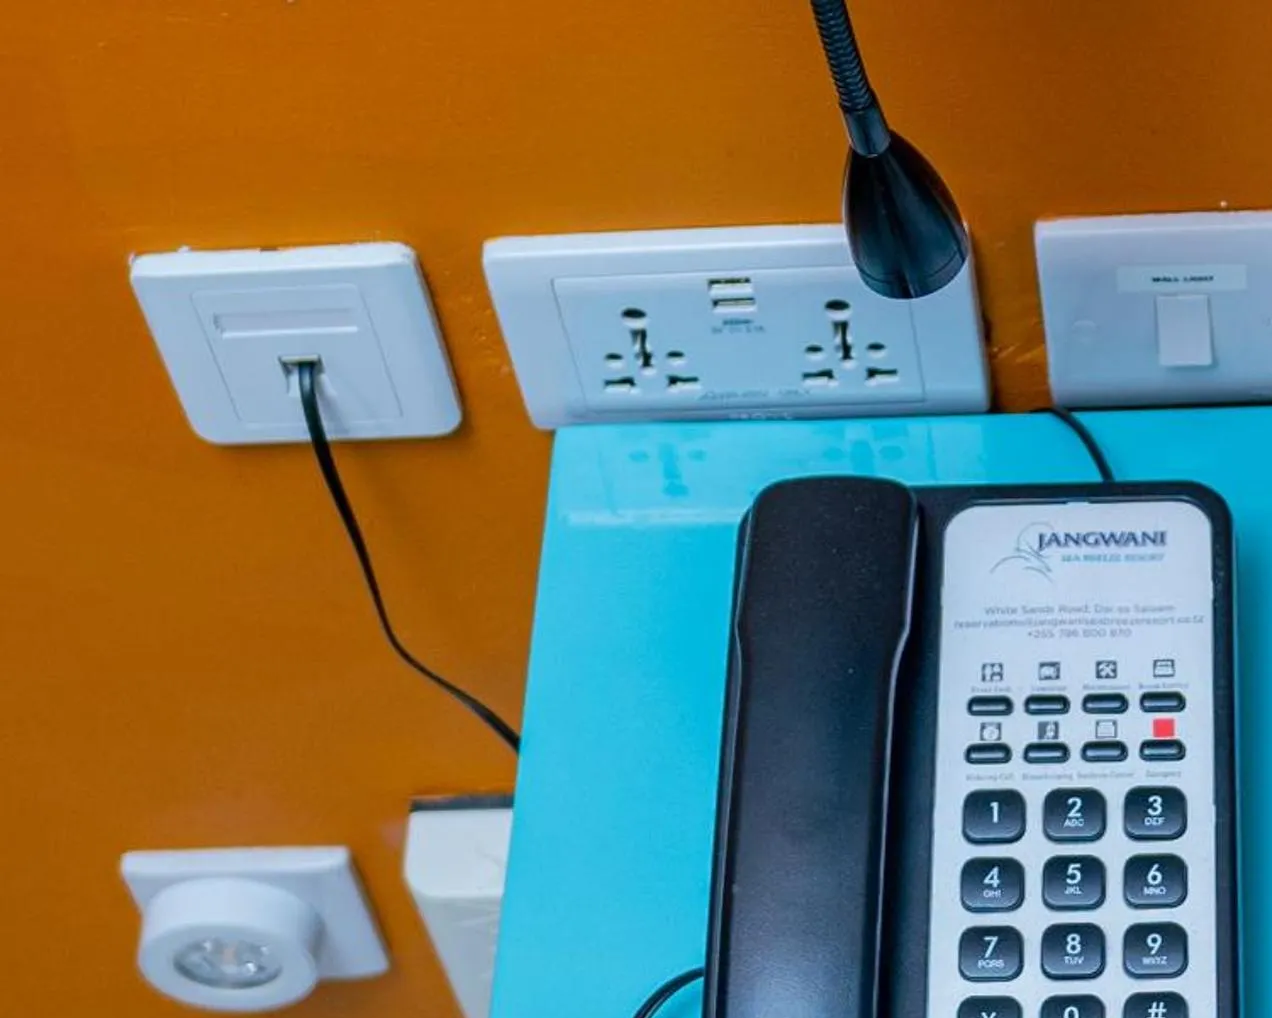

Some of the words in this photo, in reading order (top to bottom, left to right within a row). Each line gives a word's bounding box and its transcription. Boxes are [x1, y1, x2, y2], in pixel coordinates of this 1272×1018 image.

[1038, 530, 1167, 551] JANGWANI
[990, 802, 999, 823] 1
[1067, 797, 1083, 818] 2
[1147, 795, 1163, 816] 3
[1063, 818, 1085, 827] ABC
[1144, 817, 1166, 826] DEF
[983, 866, 1000, 888] 4
[1066, 863, 1082, 885] 5
[1147, 863, 1163, 885] 6
[982, 889, 1002, 898] GHI
[1064, 886, 1083, 895] JKL
[1143, 886, 1166, 896] MNO
[983, 936, 999, 958] 7
[1066, 933, 1081, 955] 8
[1146, 933, 1163, 955] 9
[1063, 956, 1085, 965] TUV
